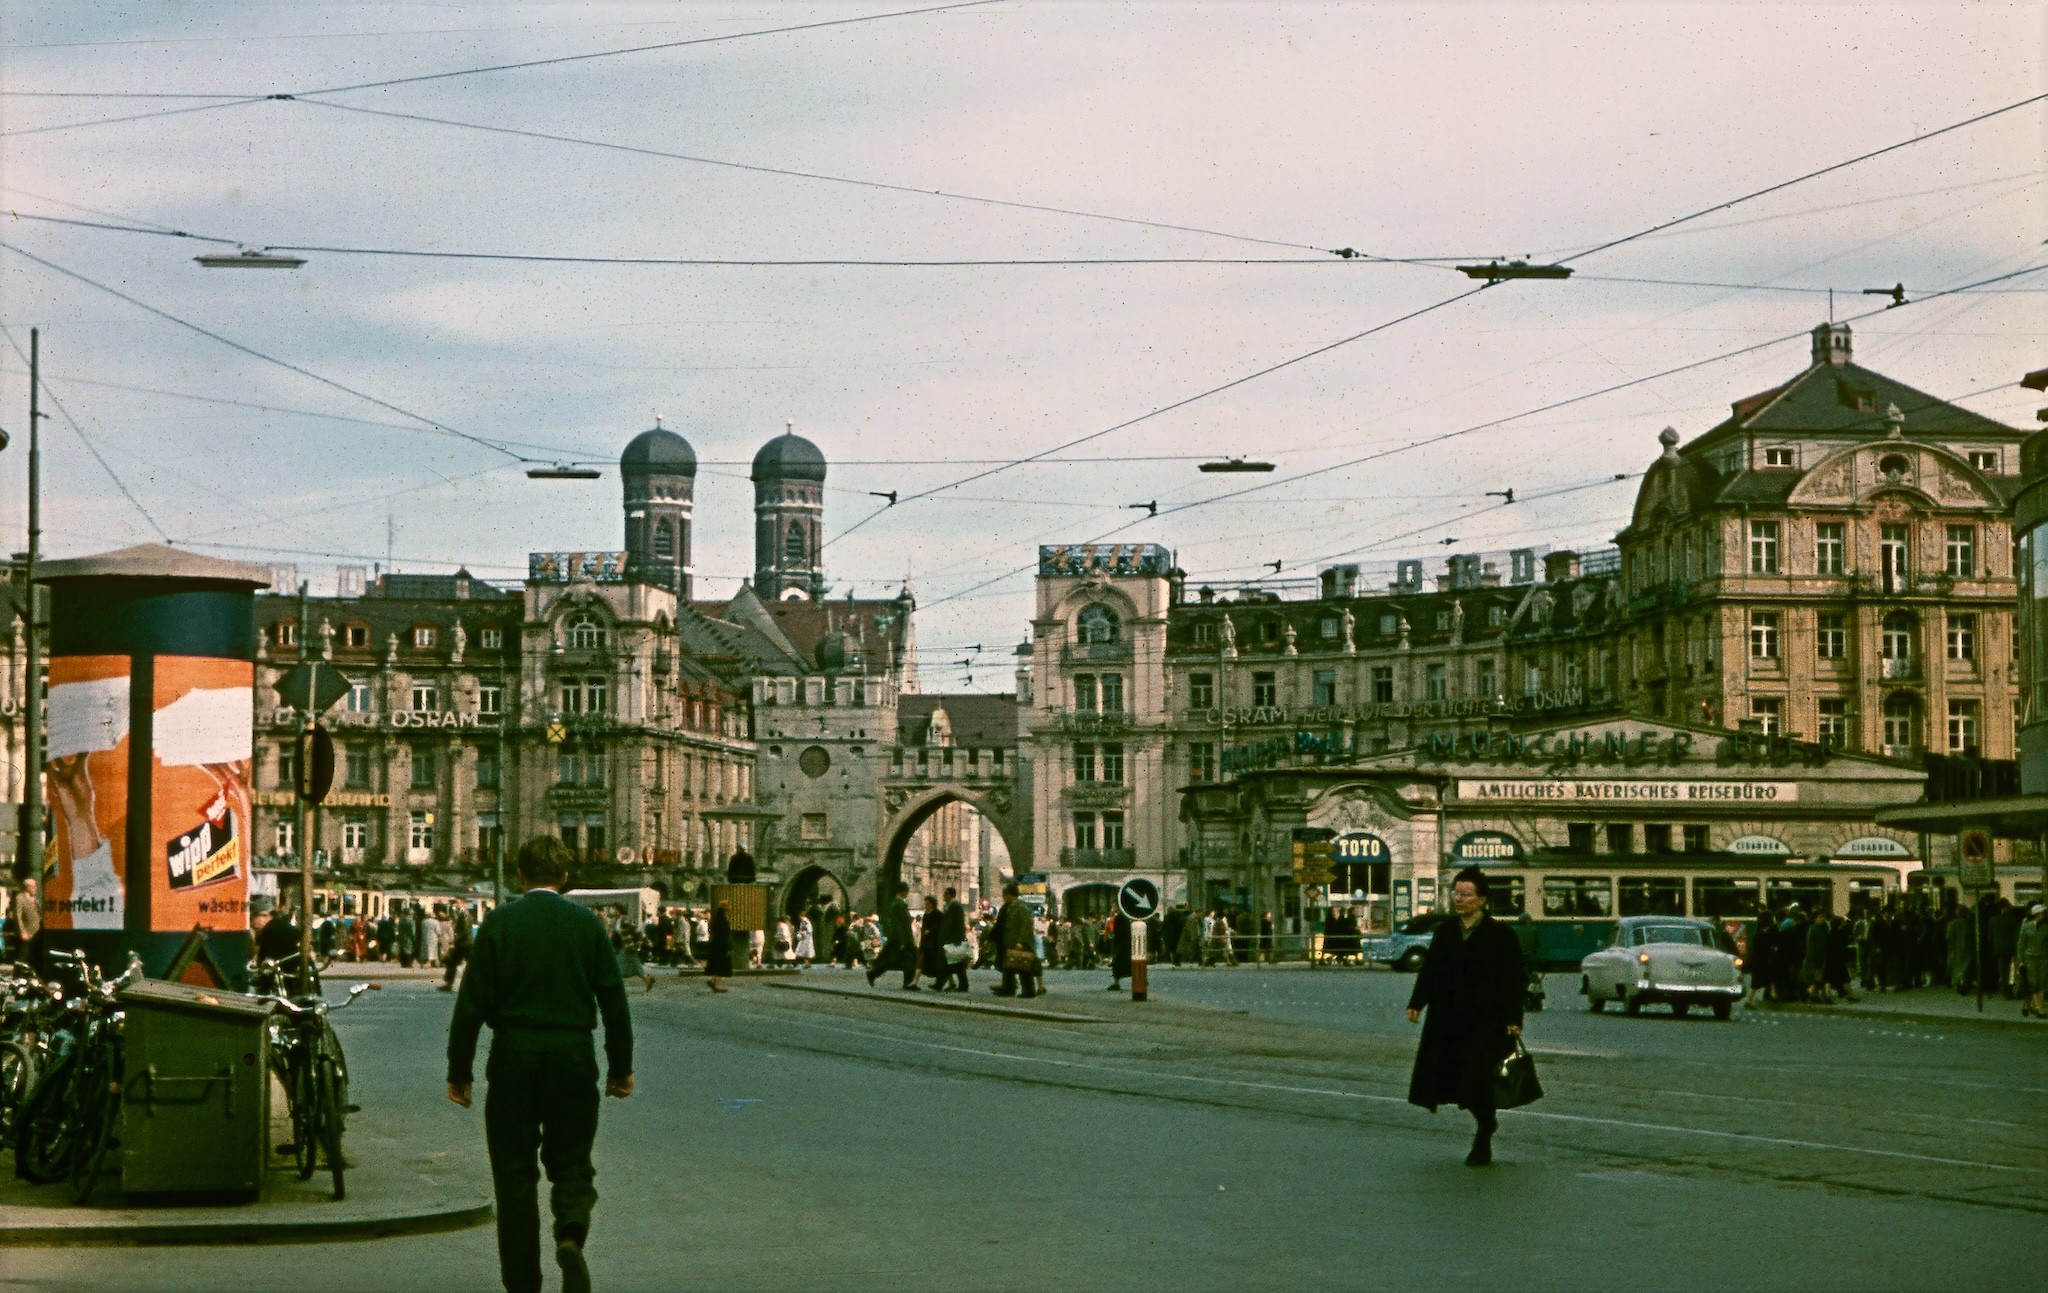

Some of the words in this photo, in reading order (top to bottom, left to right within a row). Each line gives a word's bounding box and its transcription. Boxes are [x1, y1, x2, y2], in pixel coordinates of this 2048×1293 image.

[539, 552, 628, 576] 4711
[1049, 544, 1146, 568] 4711
[1206, 705, 1288, 724] OSRAM
[1533, 688, 1583, 710] OSRAM
[391, 710, 479, 728] OSRAM
[1478, 784, 1565, 798] AMTLICHES
[1575, 783, 1679, 799] BAYERISCHES
[1687, 782, 1777, 799] REISEBÜRO
[1339, 839, 1380, 857] TOTO
[196, 842, 237, 881] perfekt
